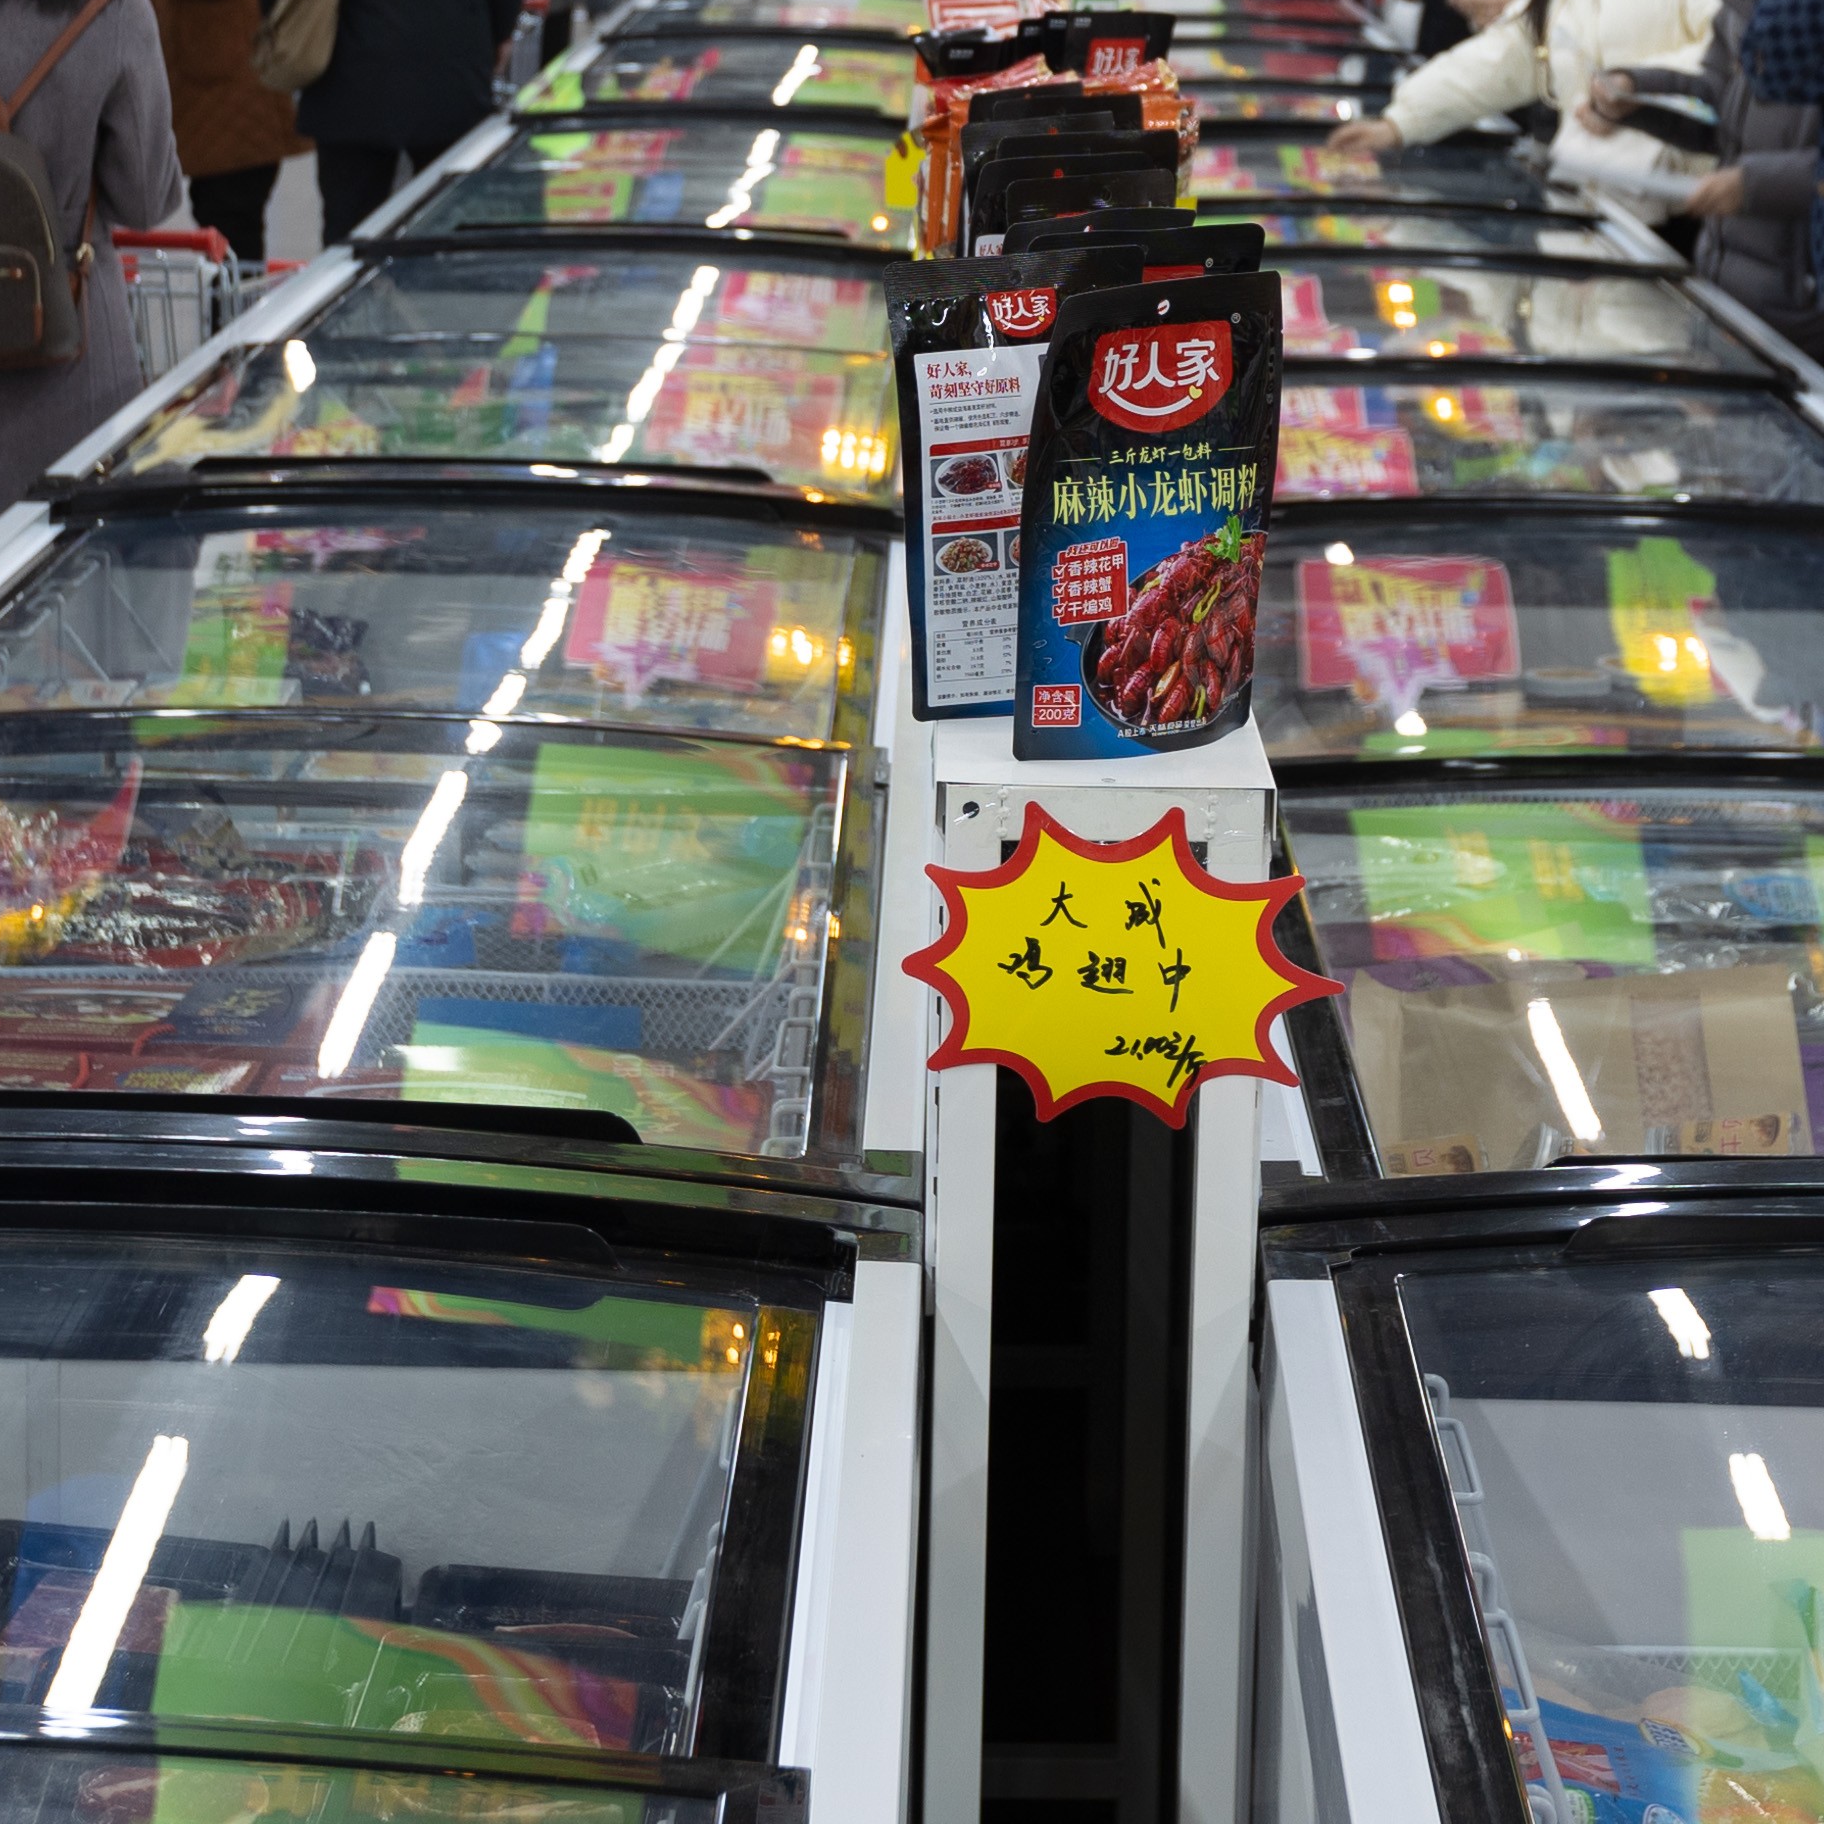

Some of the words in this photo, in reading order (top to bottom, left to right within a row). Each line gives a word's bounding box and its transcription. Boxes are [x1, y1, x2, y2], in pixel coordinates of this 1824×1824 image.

[1092, 46, 1142, 75] 好人家
[991, 294, 1052, 321] 好人家
[1098, 338, 1221, 394] 好人家
[929, 376, 1021, 399] 苛刻坚守好原料
[1108, 441, 1213, 466] 三斤龙虾一包料
[1052, 462, 1258, 525] 麻辣小龙虾调料
[1067, 553, 1124, 577] 香辣花甲
[1067, 576, 1113, 597] 香辣蟹
[1067, 596, 1113, 618] 干煸鸡
[1038, 689, 1076, 704] 净含量
[1038, 707, 1077, 722] 200克
